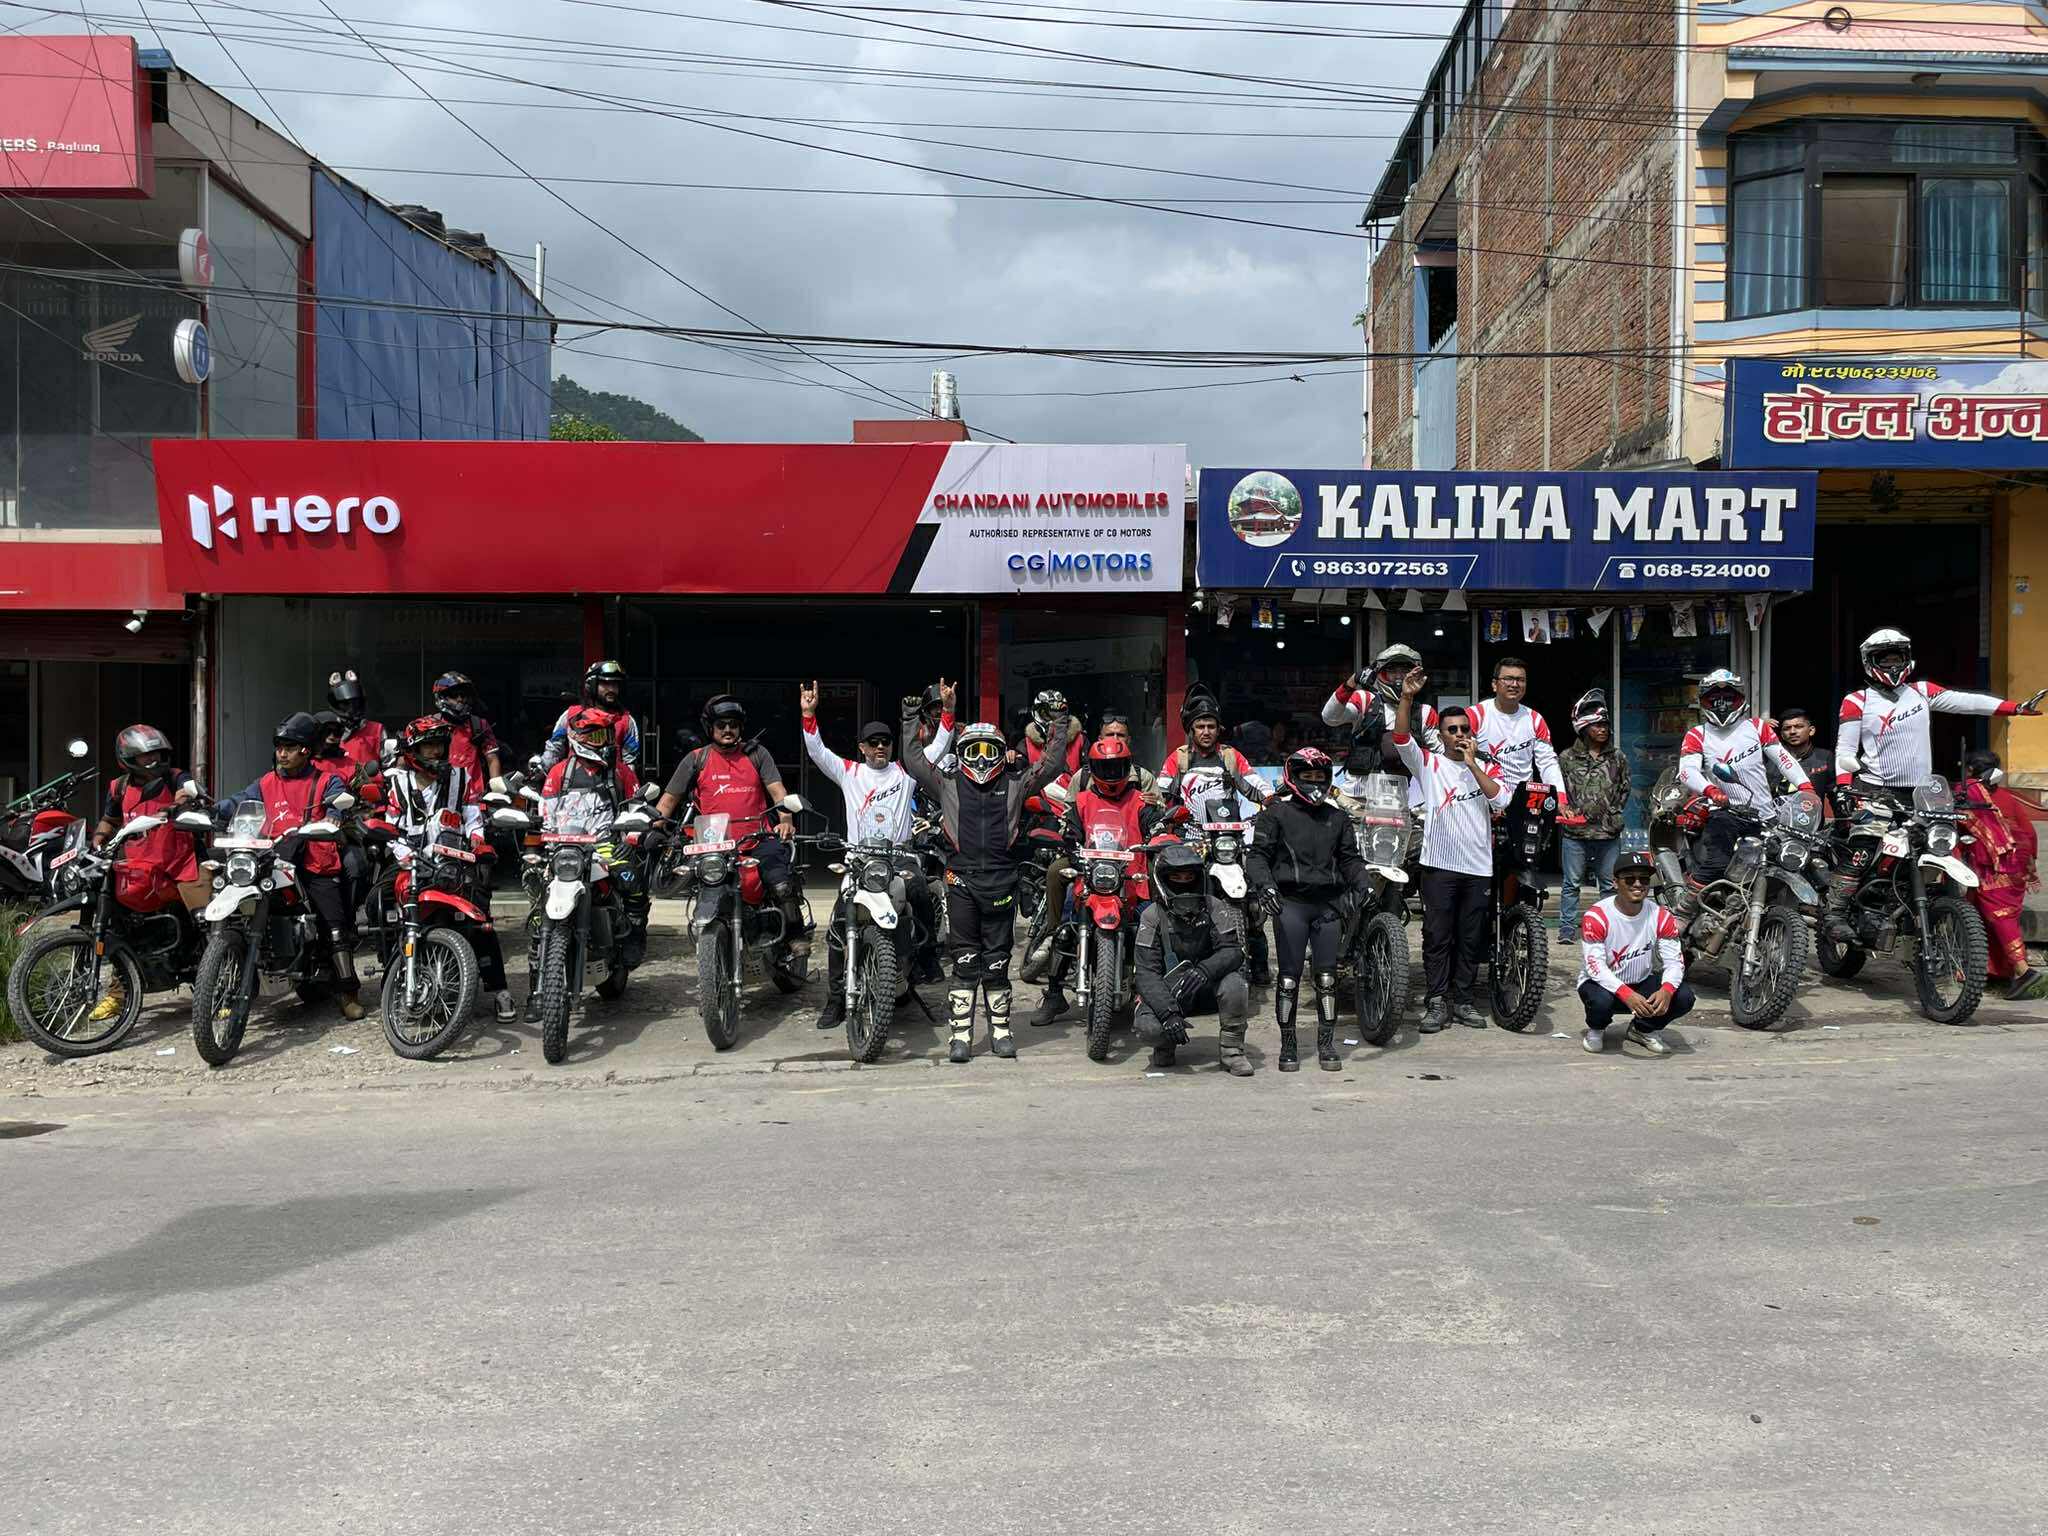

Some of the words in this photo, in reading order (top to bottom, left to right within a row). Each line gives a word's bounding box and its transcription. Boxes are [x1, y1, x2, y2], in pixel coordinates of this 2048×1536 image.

[0, 139, 44, 153] ERS,
[47, 141, 101, 154] Baglung
[82, 352, 144, 362] HONDA
[1763, 383, 1920, 443] होटल
[933, 493, 1029, 510] CHANDANI
[1036, 493, 1169, 509] AUTOMOBILES
[251, 495, 401, 534] Hero
[1317, 484, 1571, 540] KALIKA
[1592, 487, 1797, 542] MART
[969, 529, 1019, 538] AUTHORISED
[1022, 529, 1090, 538] REPRESENTATIVE
[1093, 529, 1104, 538] OF
[1120, 528, 1152, 538] MOTORS
[1007, 554, 1045, 572] CG
[1052, 553, 1153, 572] MOTORS
[1313, 562, 1449, 576] 9863072563
[1643, 564, 1771, 578] 068-524000
